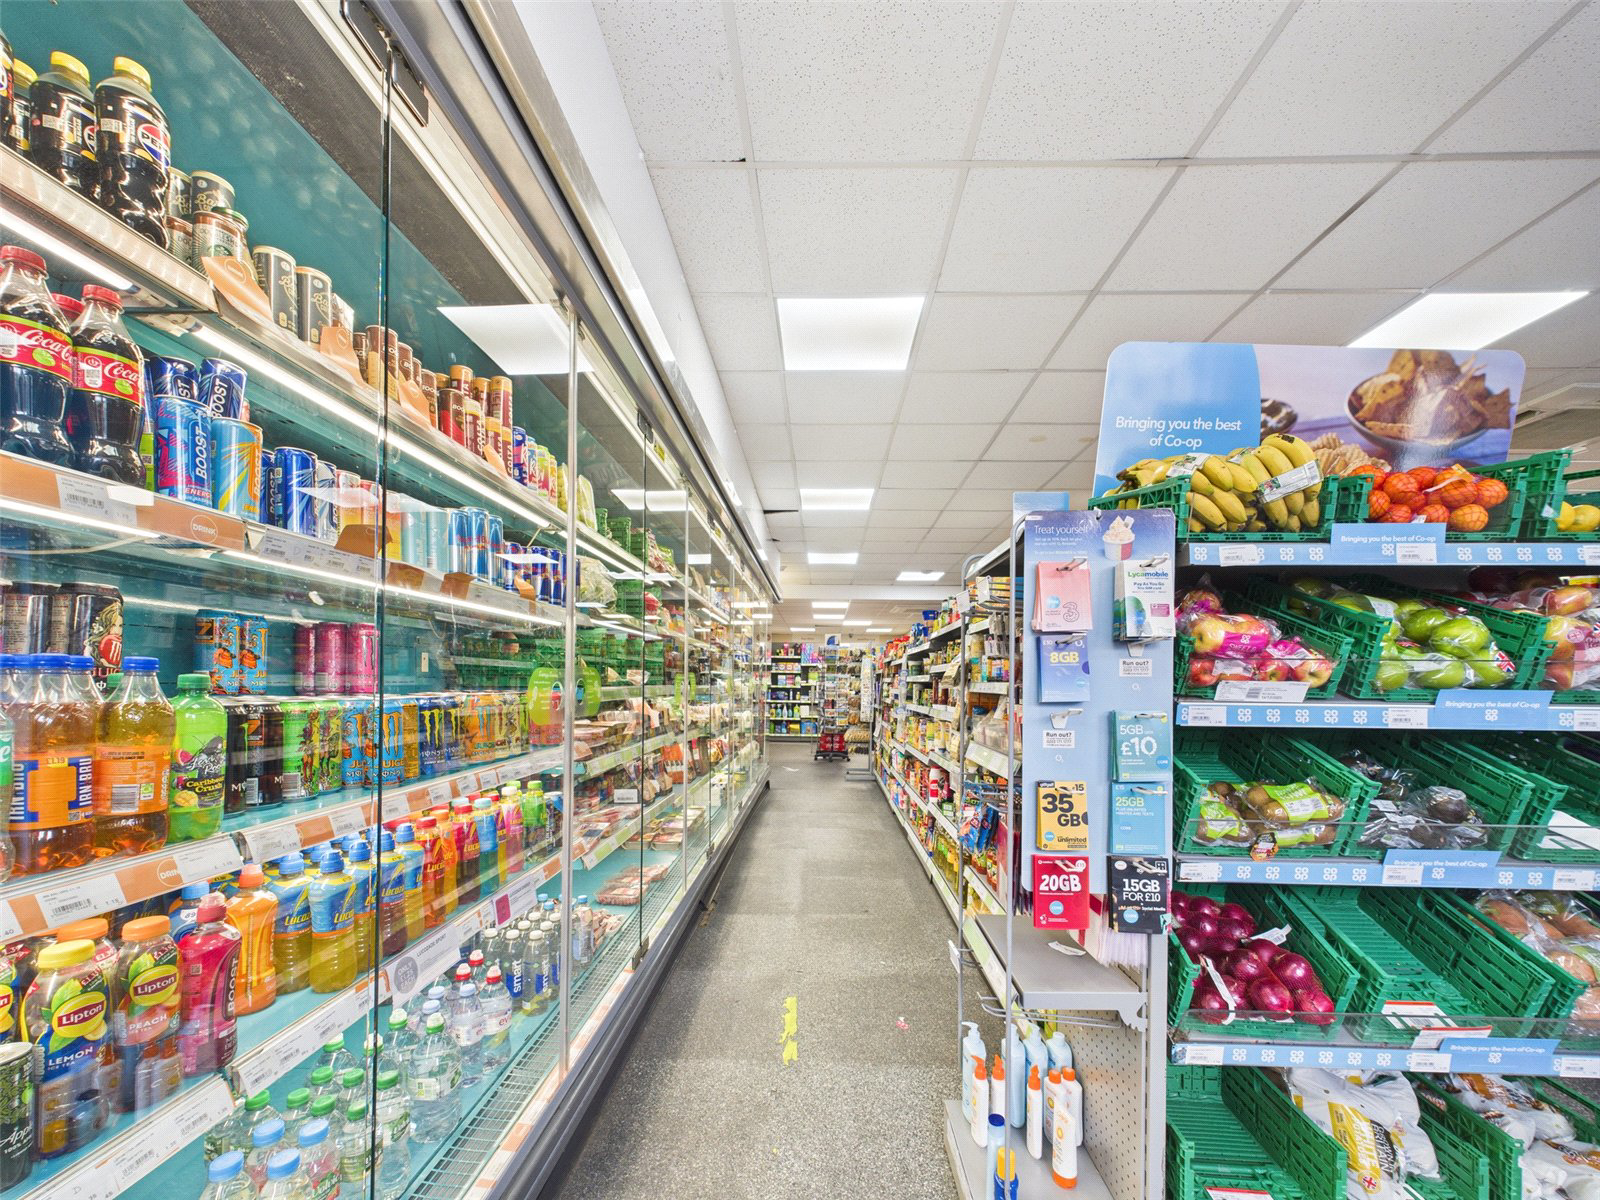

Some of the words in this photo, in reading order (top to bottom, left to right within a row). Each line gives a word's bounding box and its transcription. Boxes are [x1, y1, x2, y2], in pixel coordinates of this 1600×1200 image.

[104, 361, 140, 381] Coca
[1116, 416, 1165, 432] Bringing
[1168, 419, 1191, 432] you
[1193, 417, 1212, 430] the
[1215, 418, 1242, 431] best
[1149, 434, 1163, 447] of
[1164, 435, 1202, 450] Co-op
[195, 426, 207, 480] BOOST
[192, 523, 216, 536] DRINK
[1034, 525, 1054, 535] Treat
[1056, 525, 1089, 536] yourself
[1128, 571, 1169, 579] Lycamobile
[1062, 602, 1080, 622] 3
[1050, 651, 1079, 663] 8GB
[1520, 701, 1540, 709] Co-op
[1120, 724, 1143, 735] 5GB
[1121, 736, 1157, 756] £10
[1042, 793, 1074, 813] 35
[1116, 796, 1144, 807] 25GB
[1057, 814, 1081, 827] GB
[160, 869, 182, 880] DRIN
[1039, 874, 1082, 892] 20GB
[1123, 879, 1160, 892] 15GB
[1123, 892, 1144, 901] FOR
[1145, 892, 1161, 902] £10
[513, 958, 522, 993] smart
[137, 976, 175, 995] Lipton
[228, 958, 238, 1012] BOOST
[62, 1004, 103, 1024] Lipton
[129, 1014, 167, 1031] PEACH
[49, 1046, 93, 1066] LEMON
